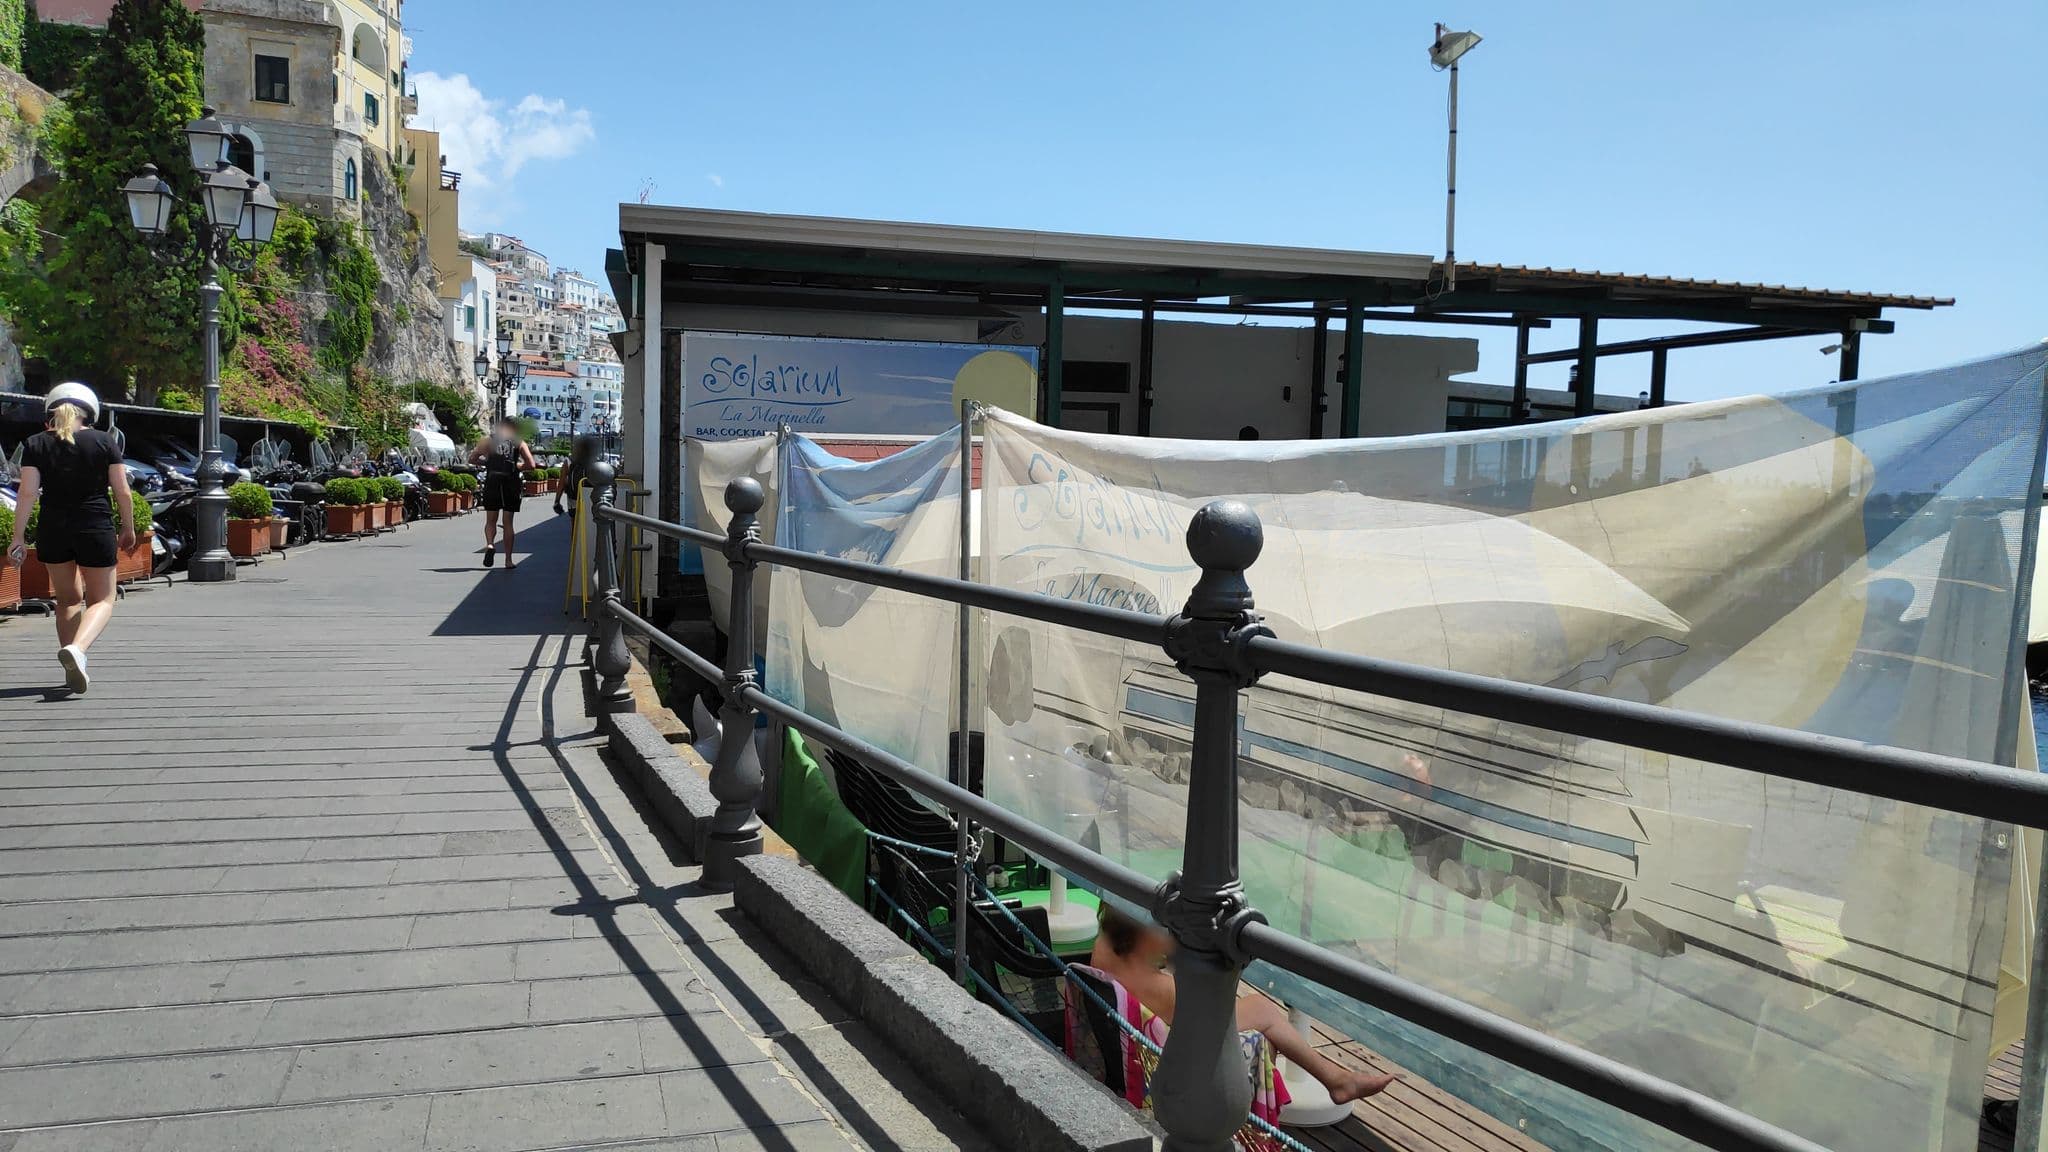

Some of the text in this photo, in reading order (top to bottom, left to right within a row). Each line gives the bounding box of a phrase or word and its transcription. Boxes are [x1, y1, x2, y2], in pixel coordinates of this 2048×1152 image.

[720, 405, 826, 425] La Marinella
[696, 427, 768, 437] BAR, COCKTAI
